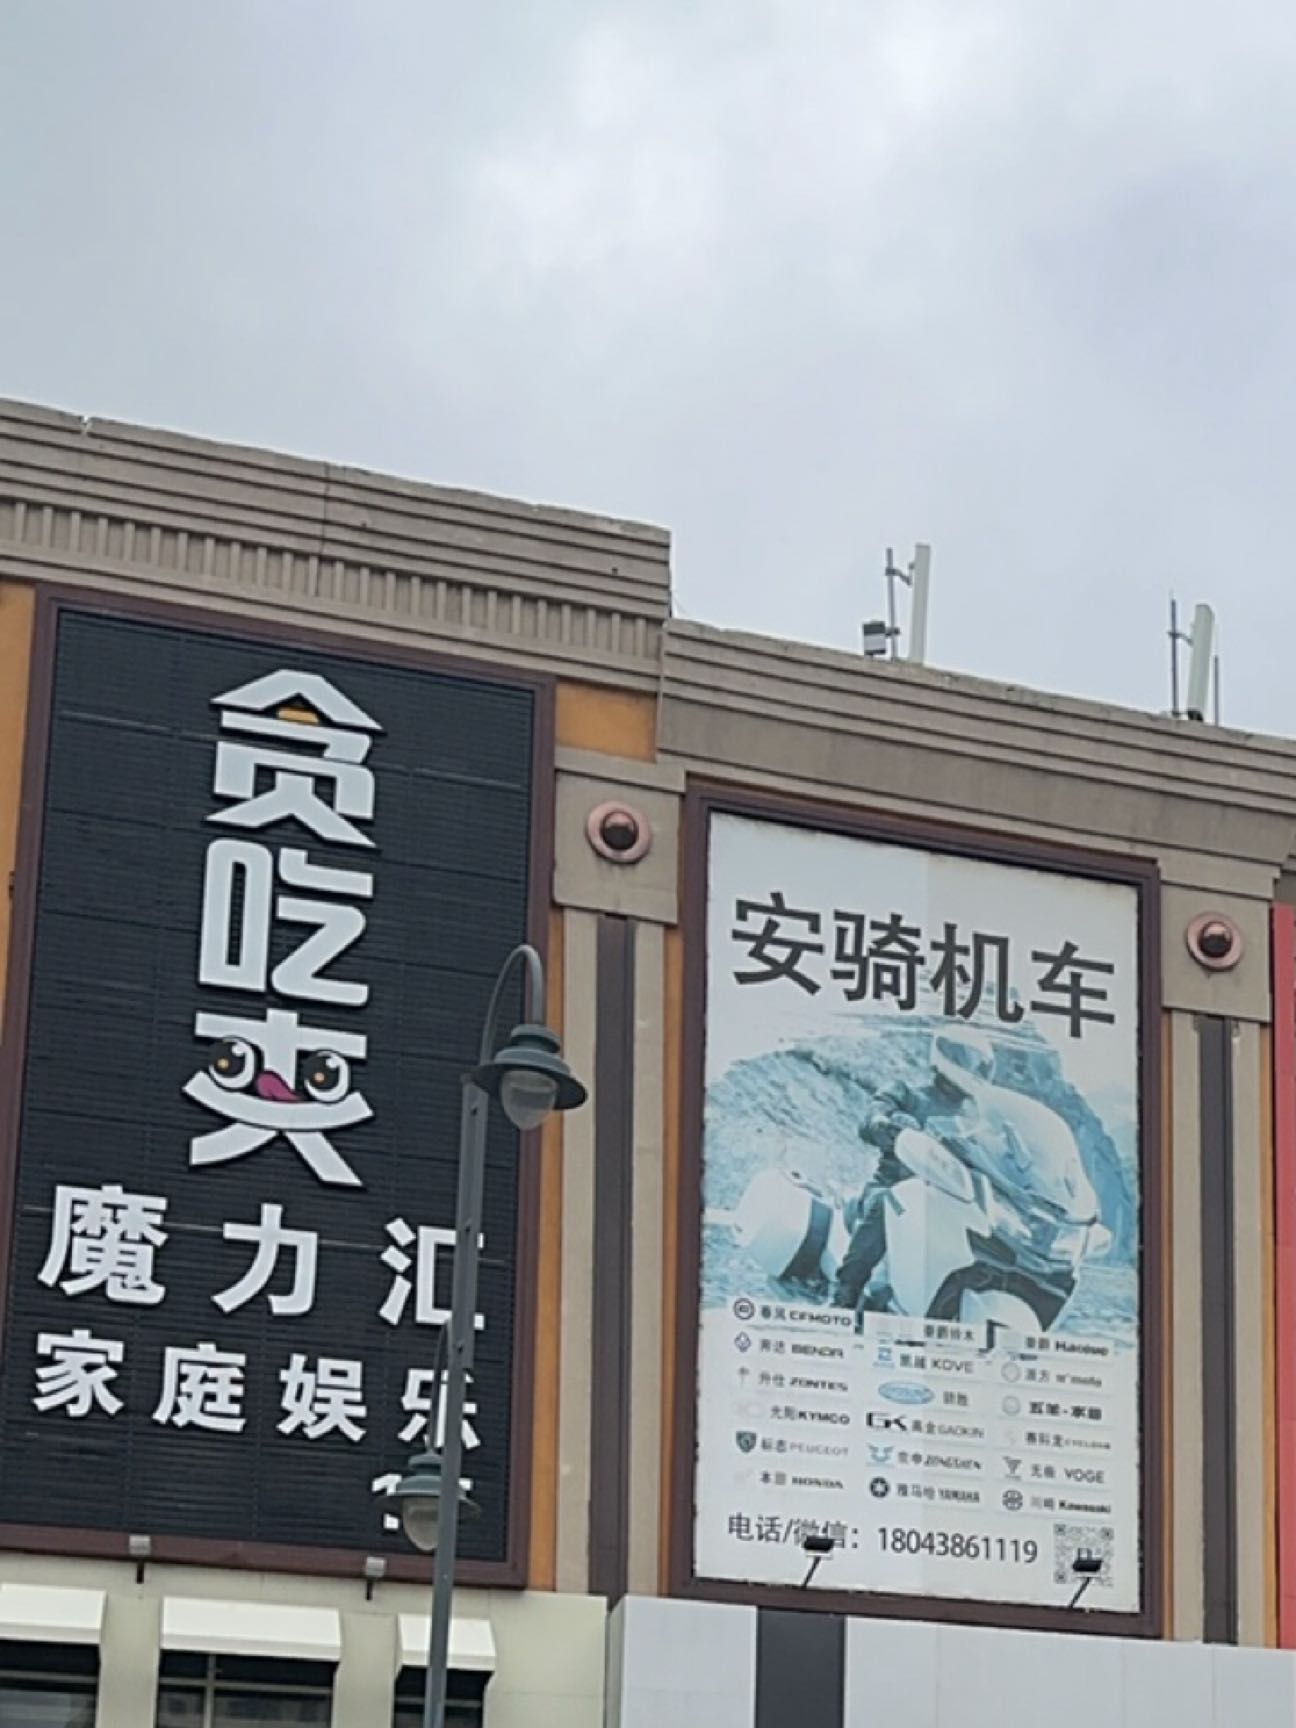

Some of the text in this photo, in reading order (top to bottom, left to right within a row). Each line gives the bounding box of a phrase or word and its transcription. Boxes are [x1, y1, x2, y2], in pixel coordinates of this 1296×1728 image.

[730, 891, 1116, 1039] 安骑机车
[37, 1183, 485, 1331] 魔力汇
[789, 1309, 853, 1326] CFMOTO
[931, 1358, 974, 1374] KOVE
[33, 1327, 482, 1450] 家庭娱乐
[1063, 1467, 1105, 1484] VOGE
[878, 1527, 1038, 1563] 18043861119
